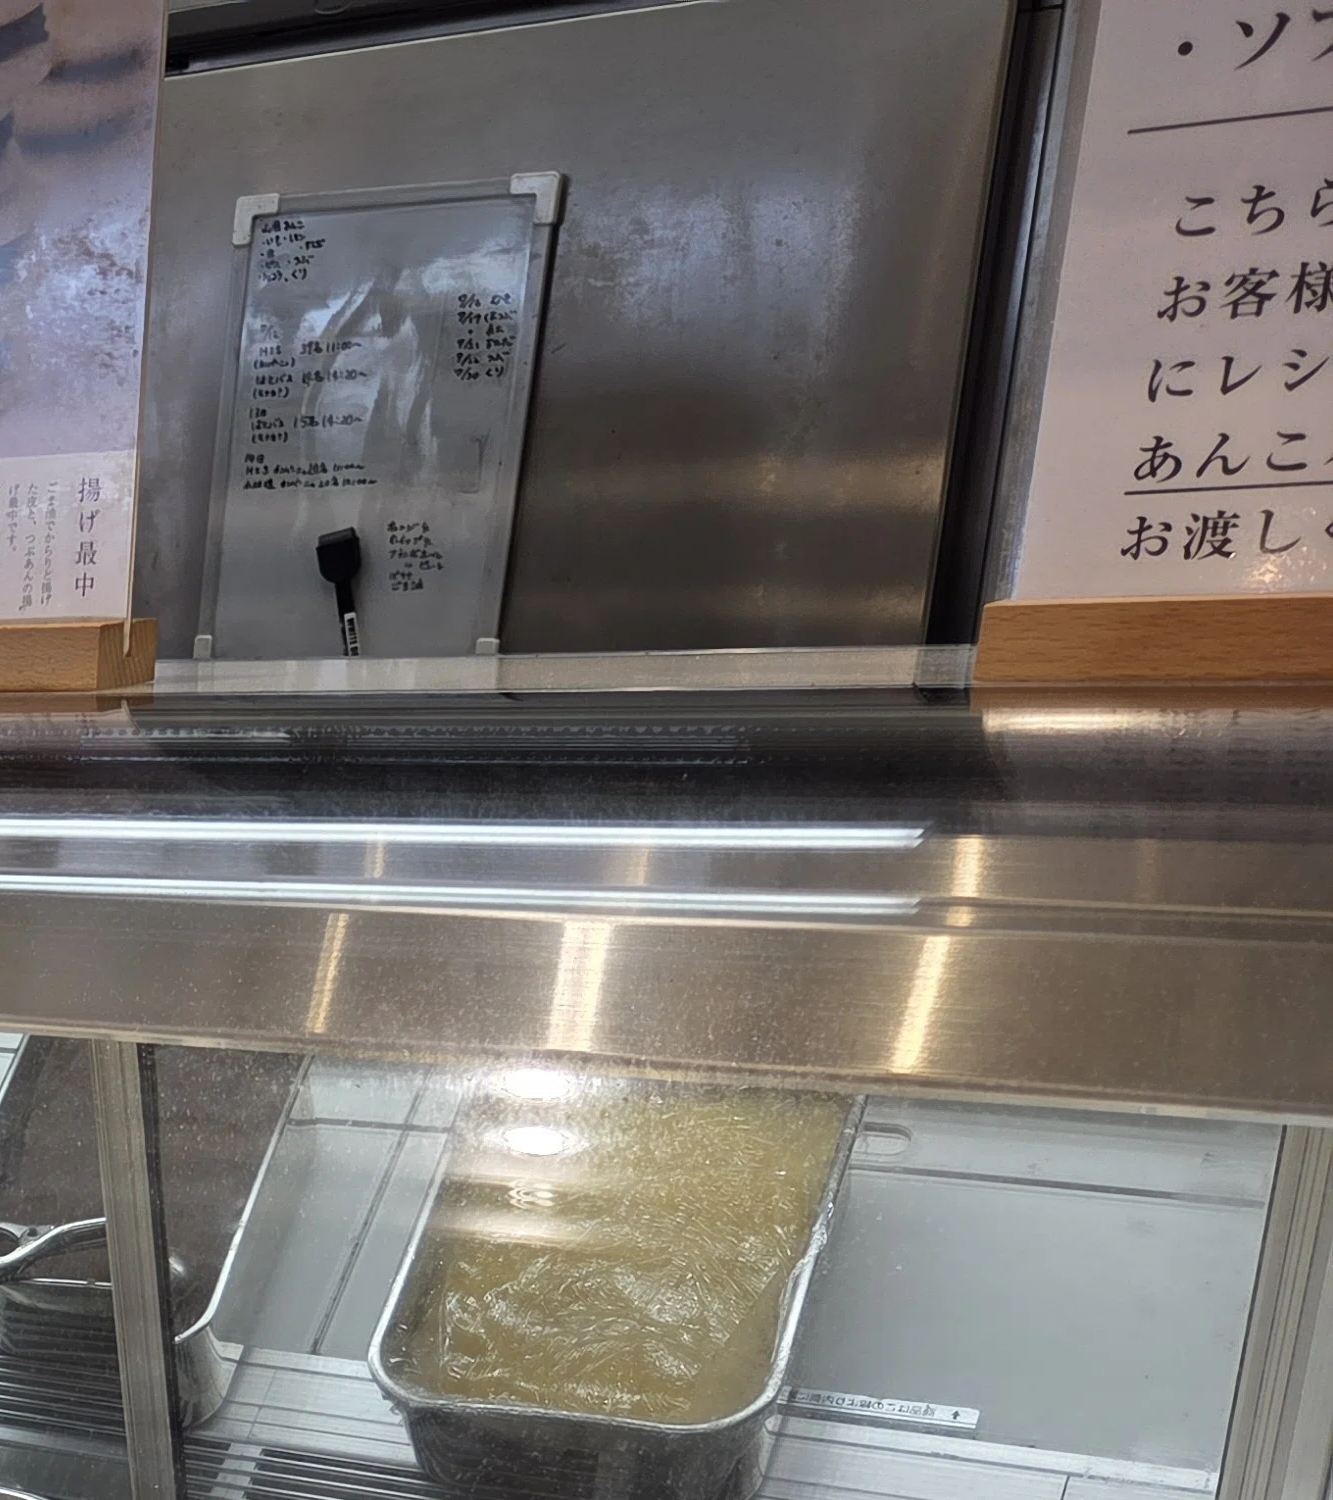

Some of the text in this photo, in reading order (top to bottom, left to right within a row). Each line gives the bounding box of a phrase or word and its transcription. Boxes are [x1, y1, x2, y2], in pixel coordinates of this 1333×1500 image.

[1156, 261, 1333, 323] お客様
[1146, 348, 1333, 404] にレシ
[1133, 429, 1333, 484] あんこ
[74, 477, 102, 598] 揚げ最中
[1119, 508, 1333, 563] お渡し
